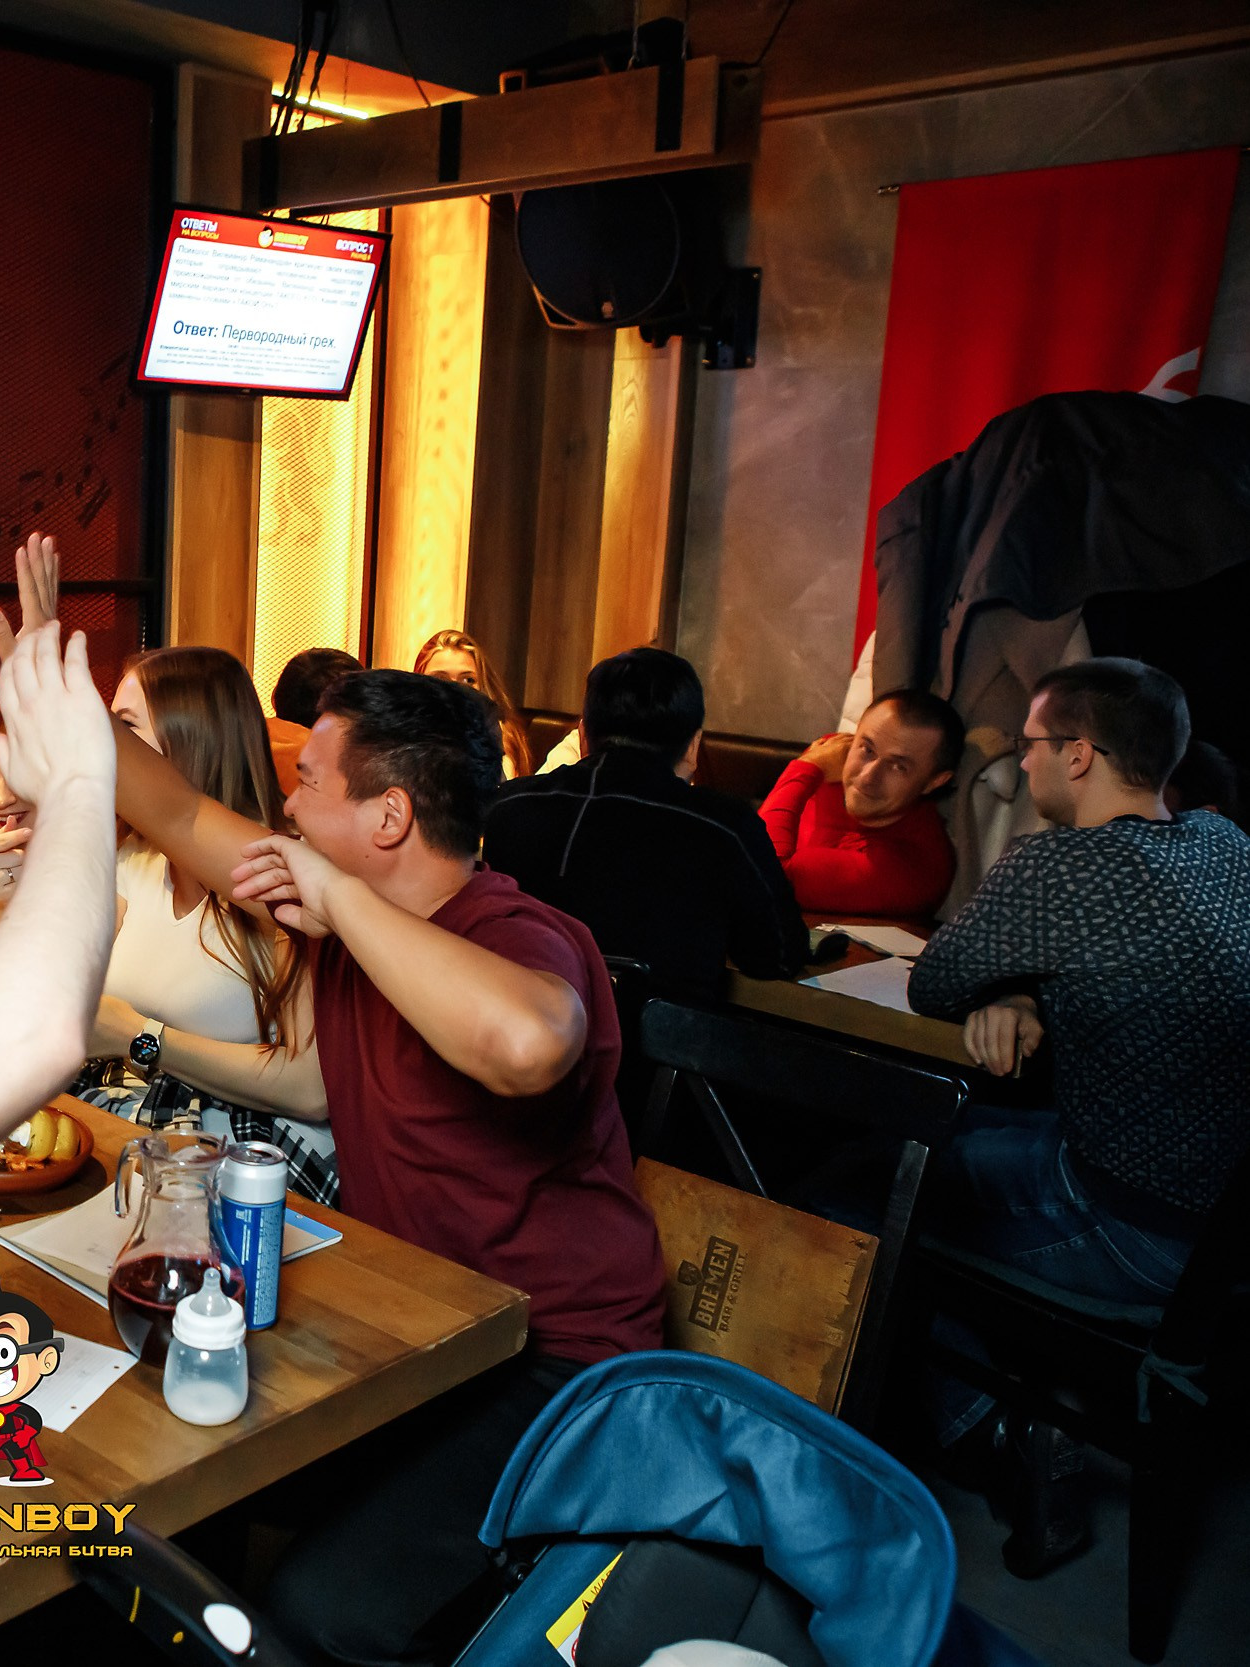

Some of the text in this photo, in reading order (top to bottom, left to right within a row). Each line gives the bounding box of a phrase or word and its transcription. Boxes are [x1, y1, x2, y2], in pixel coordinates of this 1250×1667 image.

[181, 217, 218, 232] ОТВЕТЫ
[335, 239, 369, 254] ВОПРОС
[173, 320, 337, 350] Ответ: Первородный грех.
[695, 1241, 732, 1326] BREMEN
[719, 1306, 733, 1332] BAR
